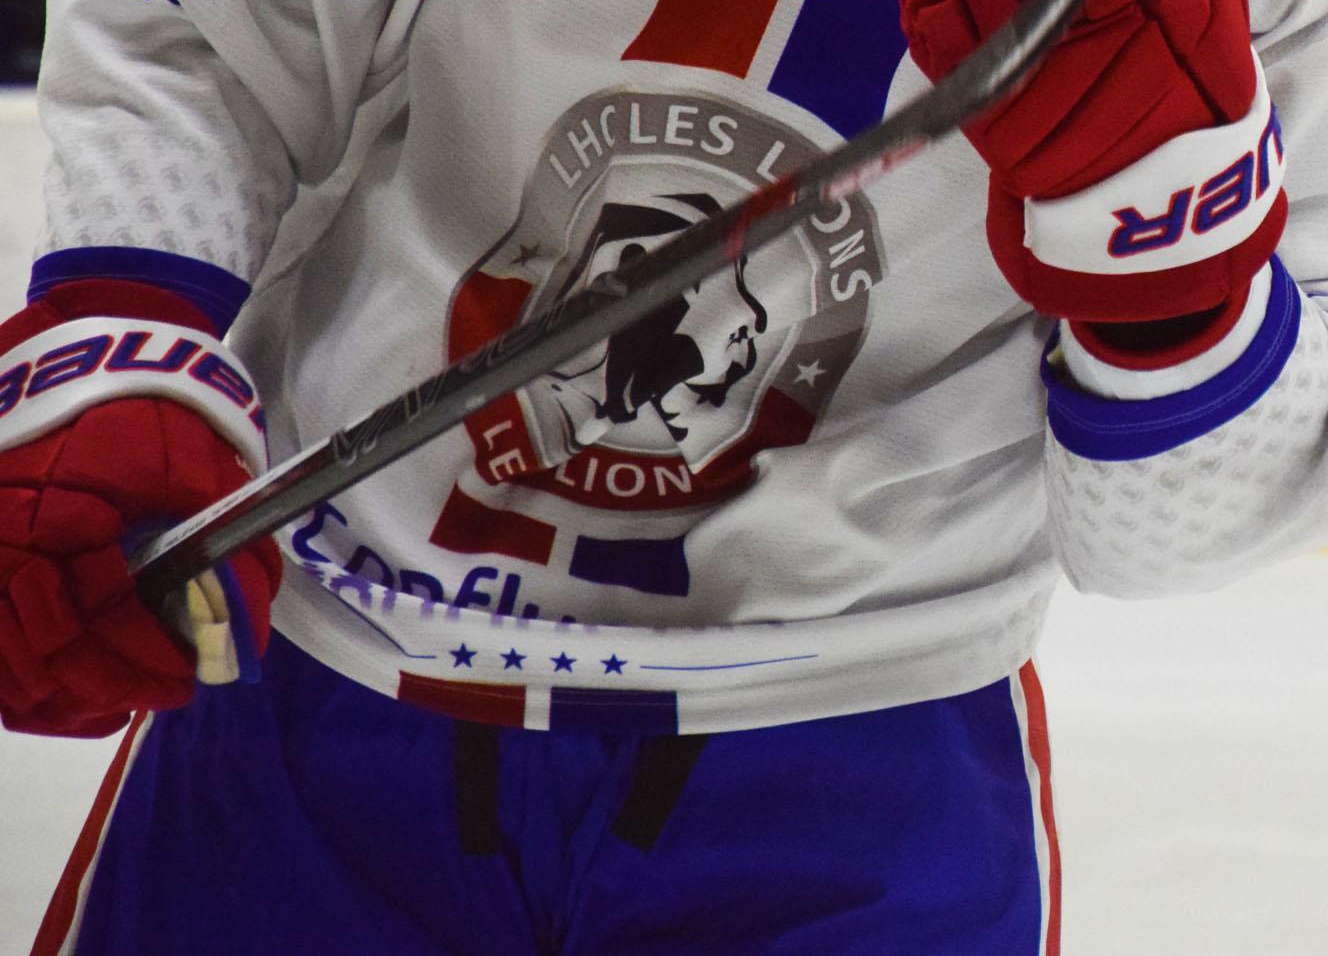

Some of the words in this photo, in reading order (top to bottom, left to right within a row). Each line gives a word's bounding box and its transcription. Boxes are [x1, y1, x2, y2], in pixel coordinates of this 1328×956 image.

[549, 104, 617, 188] LHC
[629, 102, 738, 157] LES
[482, 419, 527, 481] LE
[555, 455, 693, 494] LION
